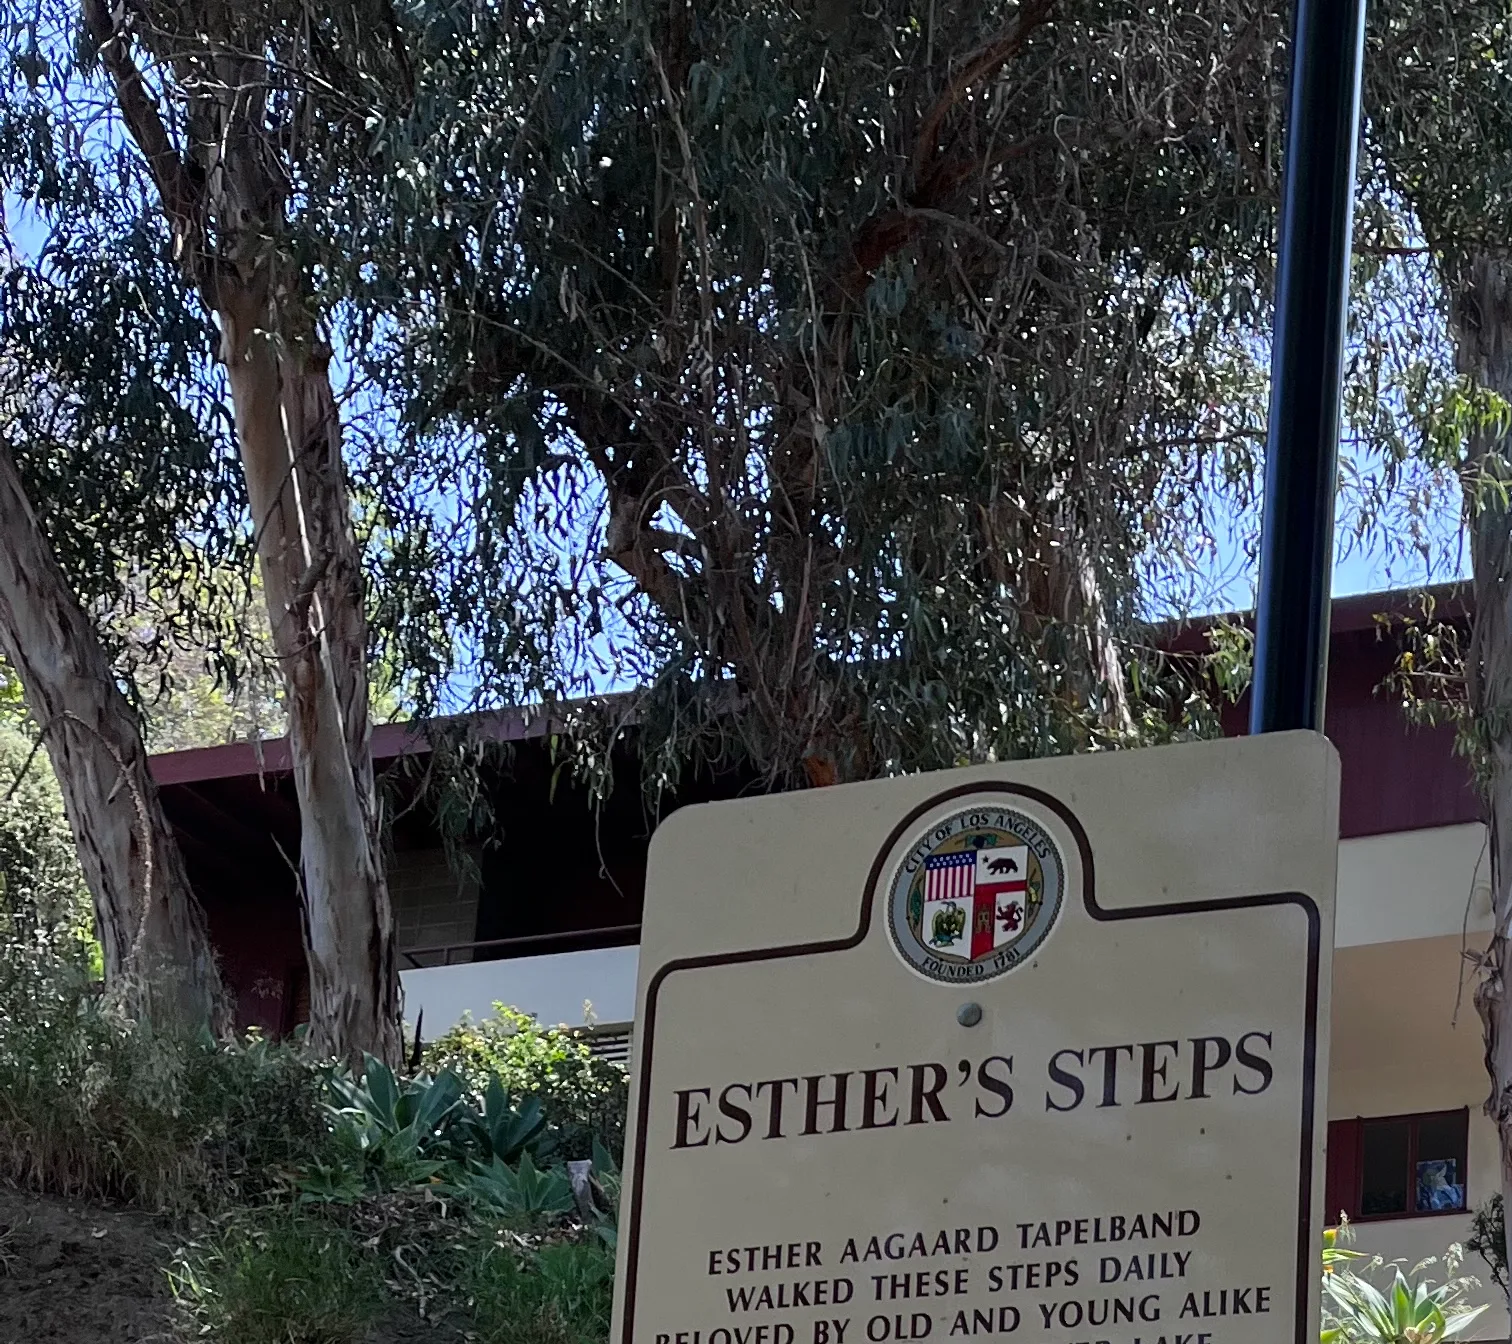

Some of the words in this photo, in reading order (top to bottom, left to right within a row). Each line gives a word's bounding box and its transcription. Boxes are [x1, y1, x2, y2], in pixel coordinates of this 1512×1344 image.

[906, 839, 933, 874] CITY
[935, 823, 951, 841] OF
[960, 814, 989, 830] LOS
[996, 815, 1051, 859] ANGELES
[922, 956, 984, 977] FOUNDED
[993, 948, 1020, 969] 1781
[669, 1056, 1013, 1149] ESTHER'S
[1046, 1032, 1273, 1112] STEPS
[709, 1241, 822, 1275] ESTHER
[840, 1227, 998, 1264] AAGAARD
[1016, 1210, 1200, 1248] TAPELBAND
[726, 1278, 853, 1312] WALKED
[871, 1269, 968, 1300] THESE
[989, 1260, 1079, 1292] STEPS
[1100, 1251, 1192, 1283] DAILY
[867, 1313, 932, 1342] OLD
[950, 1306, 1020, 1336] AND
[1039, 1295, 1160, 1329] YOUNG
[1179, 1287, 1270, 1319] ALIKE
